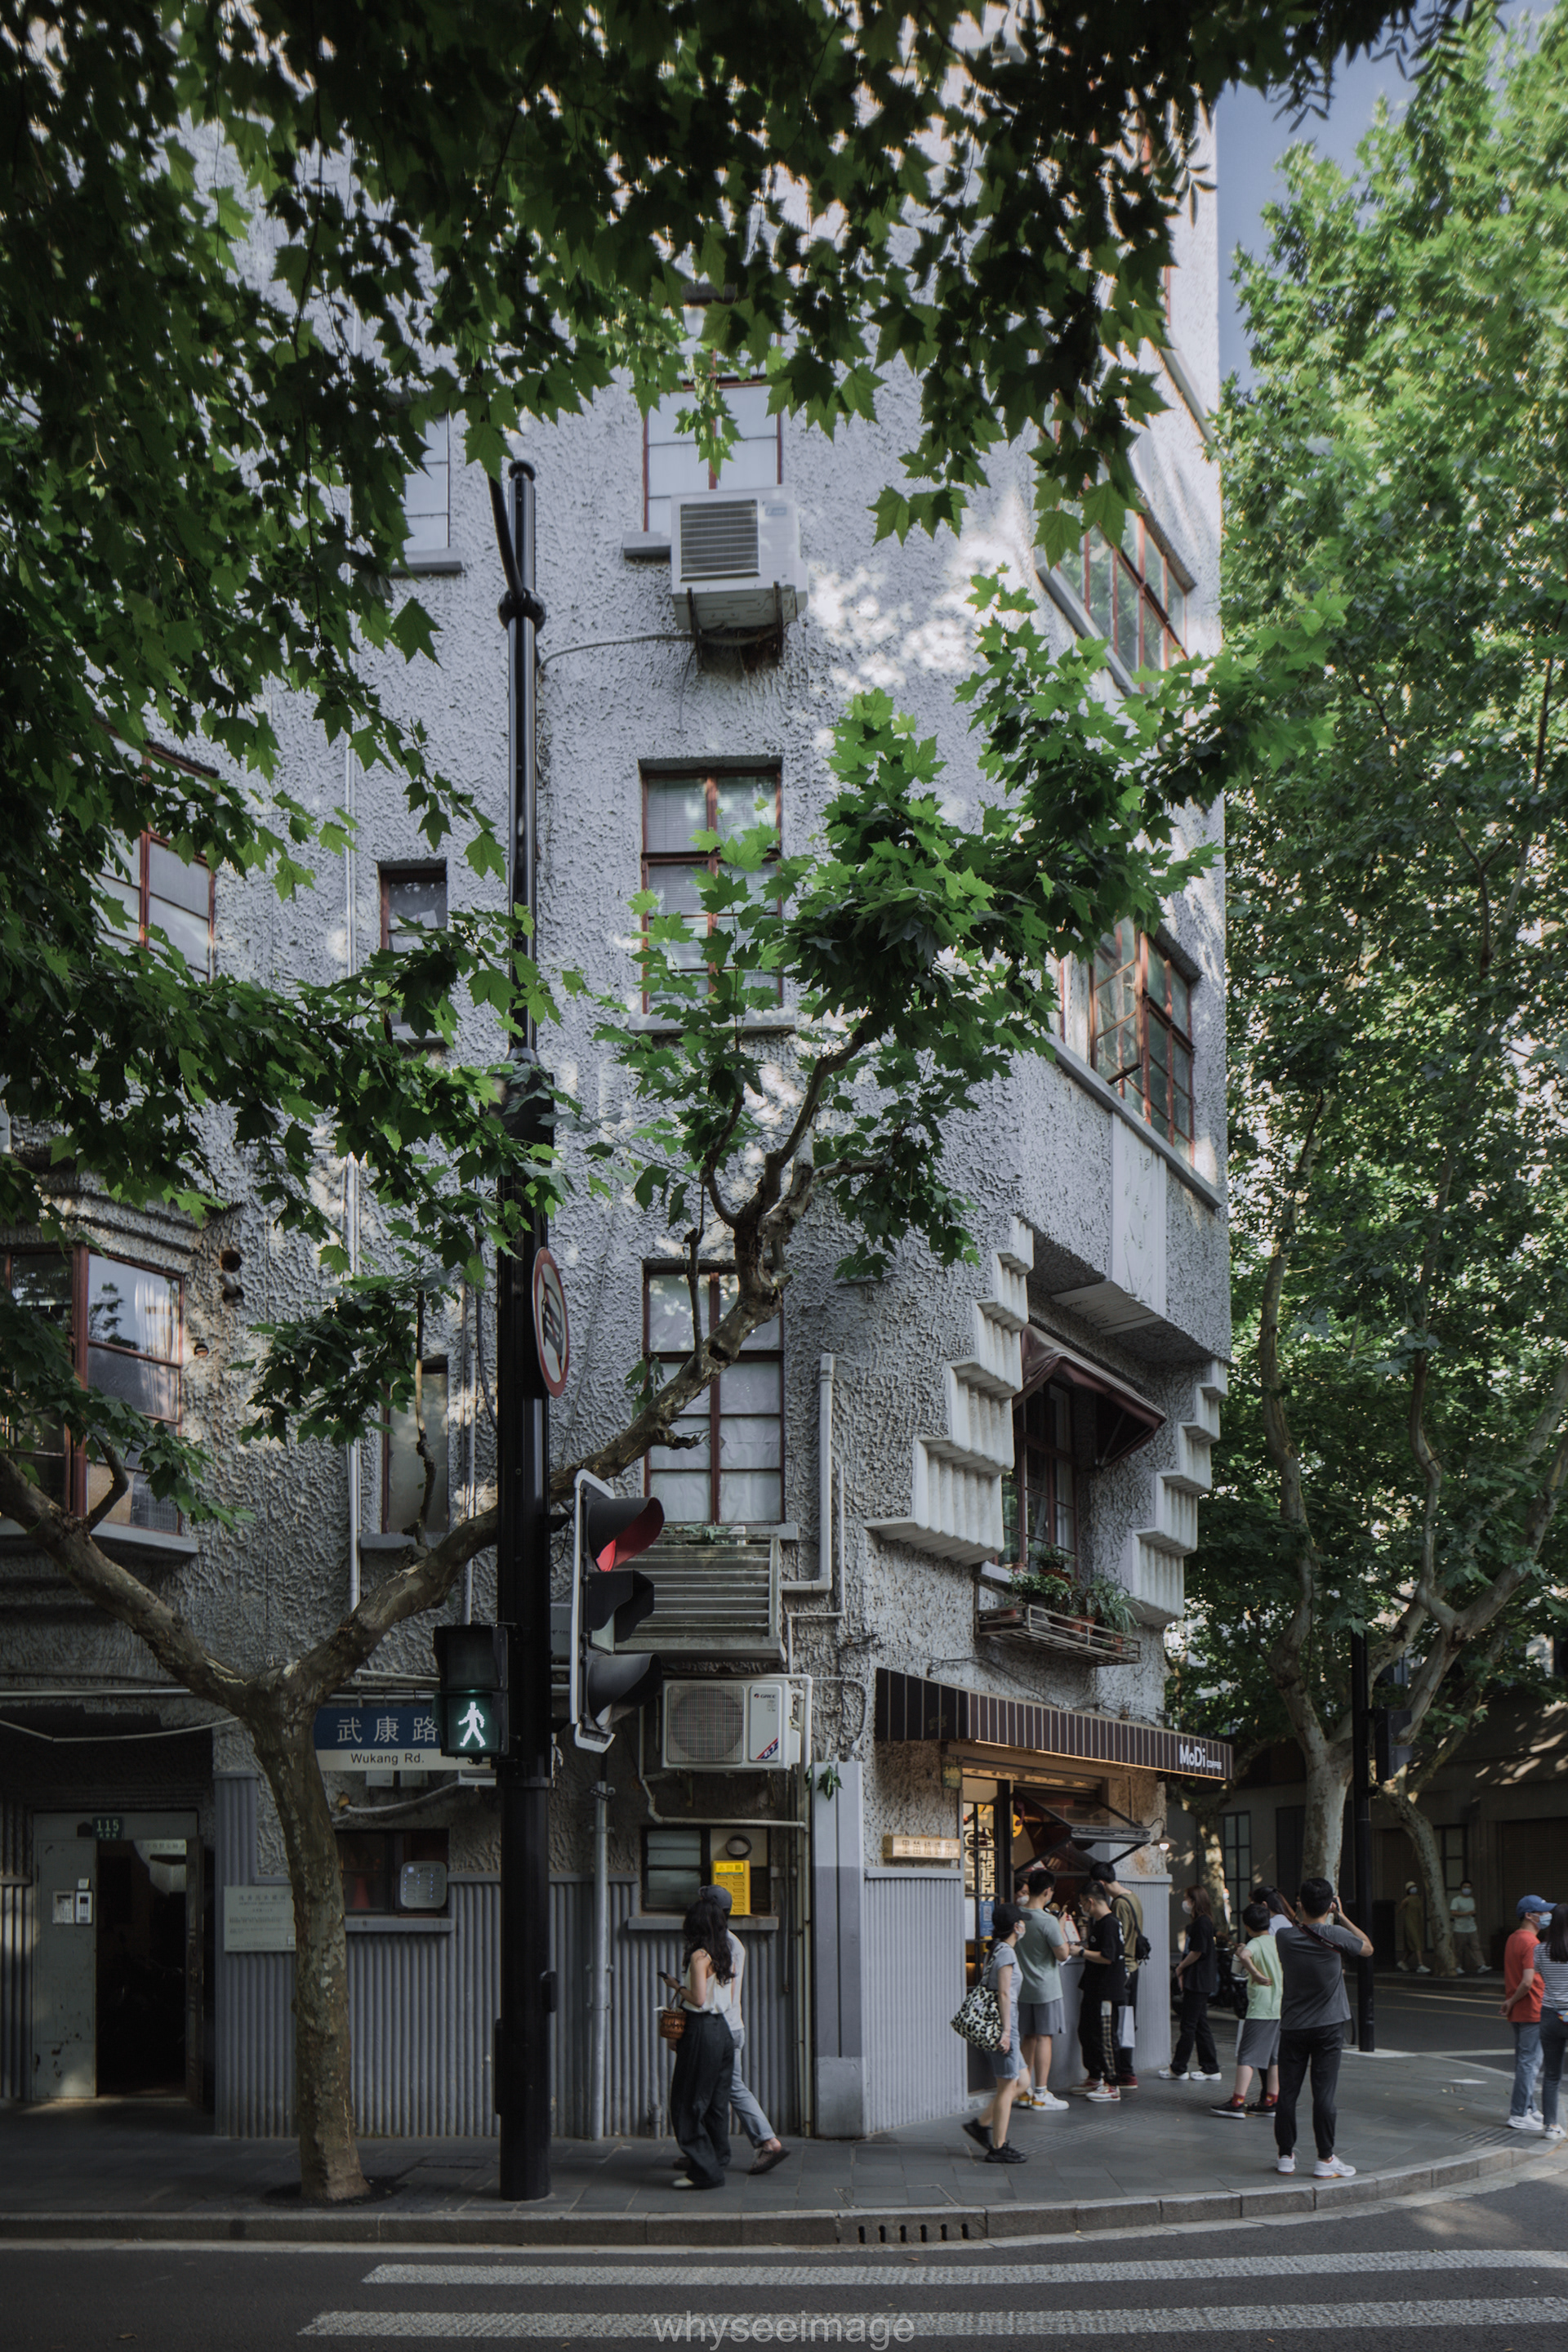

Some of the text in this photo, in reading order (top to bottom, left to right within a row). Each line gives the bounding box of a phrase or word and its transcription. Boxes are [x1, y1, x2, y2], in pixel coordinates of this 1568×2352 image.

[336, 1715, 439, 1744] 武康路
[350, 1753, 425, 1766] Wukang Rd.
[1179, 1744, 1206, 1768] MoDi
[96, 1819, 119, 1832] 115
